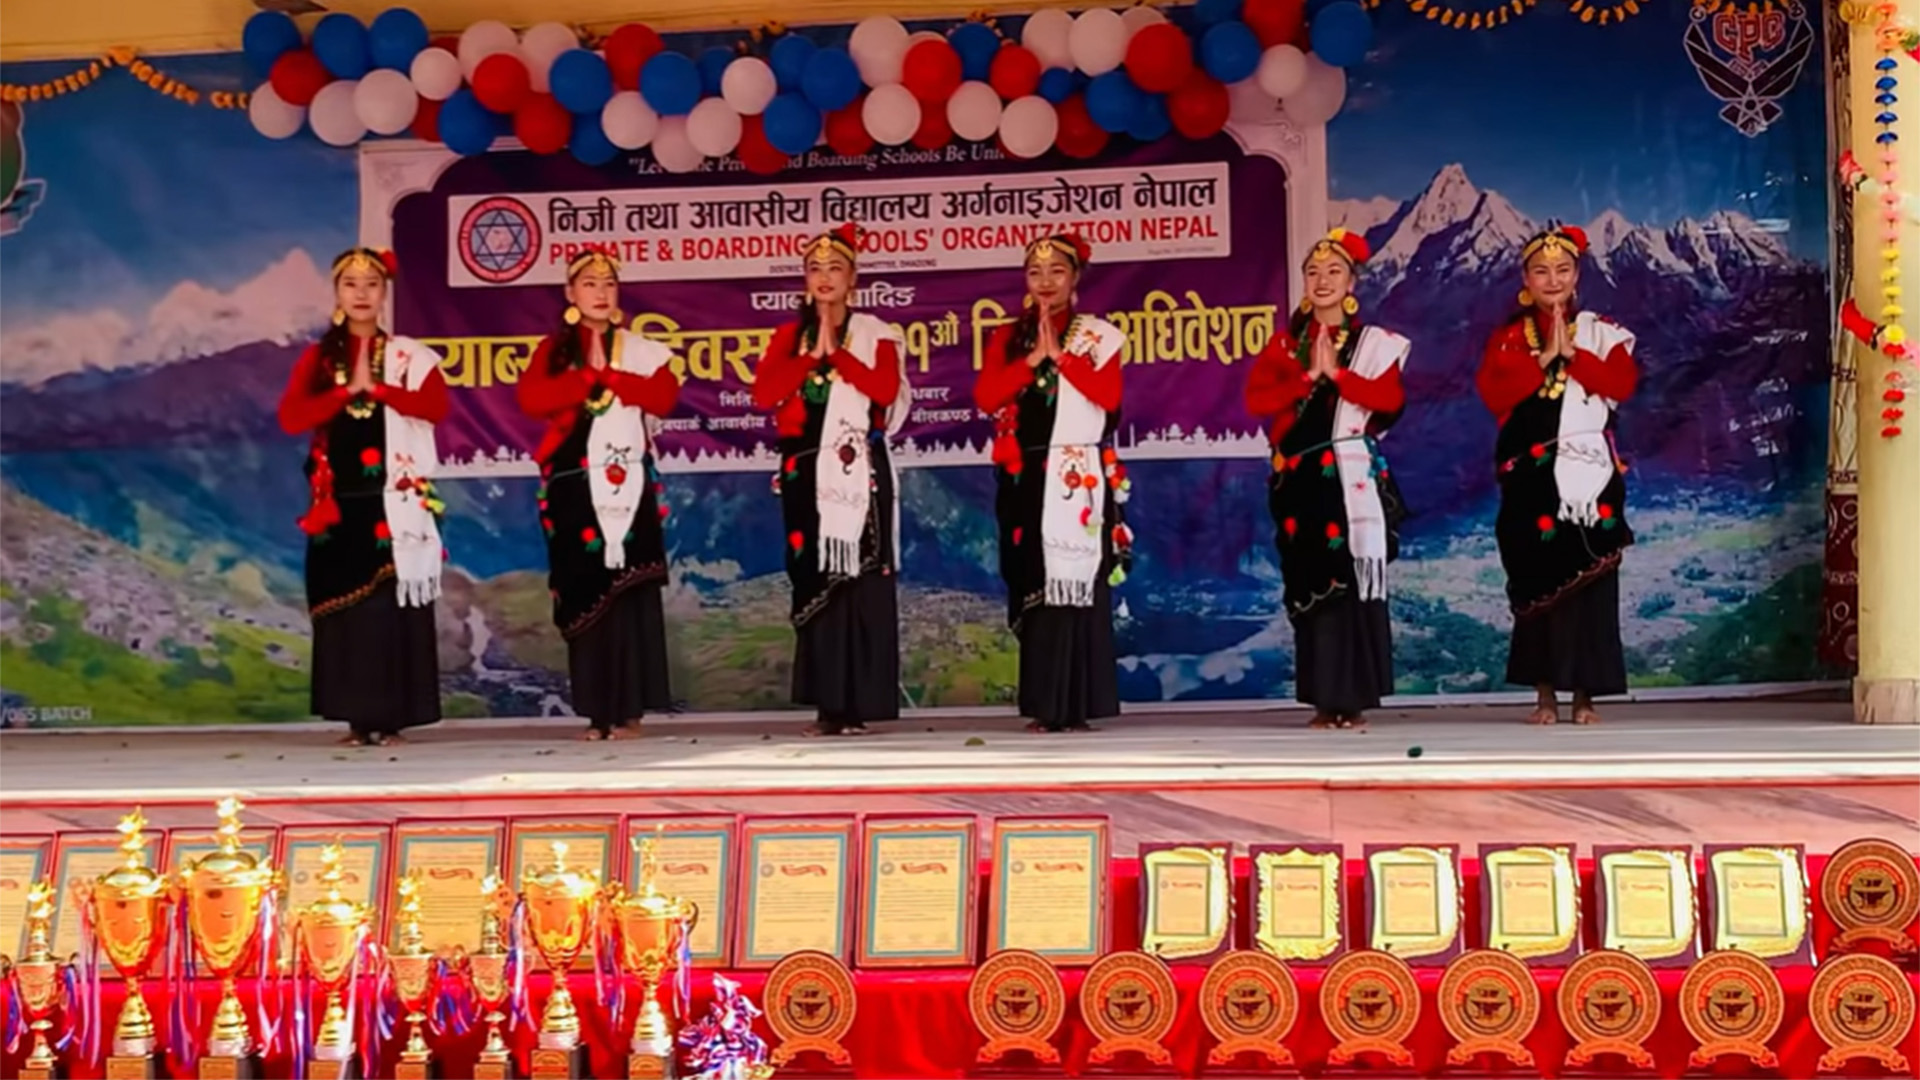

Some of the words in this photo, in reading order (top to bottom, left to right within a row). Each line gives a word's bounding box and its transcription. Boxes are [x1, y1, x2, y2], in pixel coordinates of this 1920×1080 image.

[881, 147, 941, 165] Schools
[946, 145, 966, 162] Be
[548, 196, 616, 233] निजी
[625, 202, 680, 233] तथा
[689, 191, 811, 228] आवासीय
[821, 187, 931, 222] विद्यालय
[941, 176, 1124, 219] अर्गनाइजेशन
[1133, 172, 1218, 208] नेपाल
[657, 239, 674, 262] &
[682, 234, 808, 261] BOARDING
[1141, 215, 1218, 241] NEPAL
